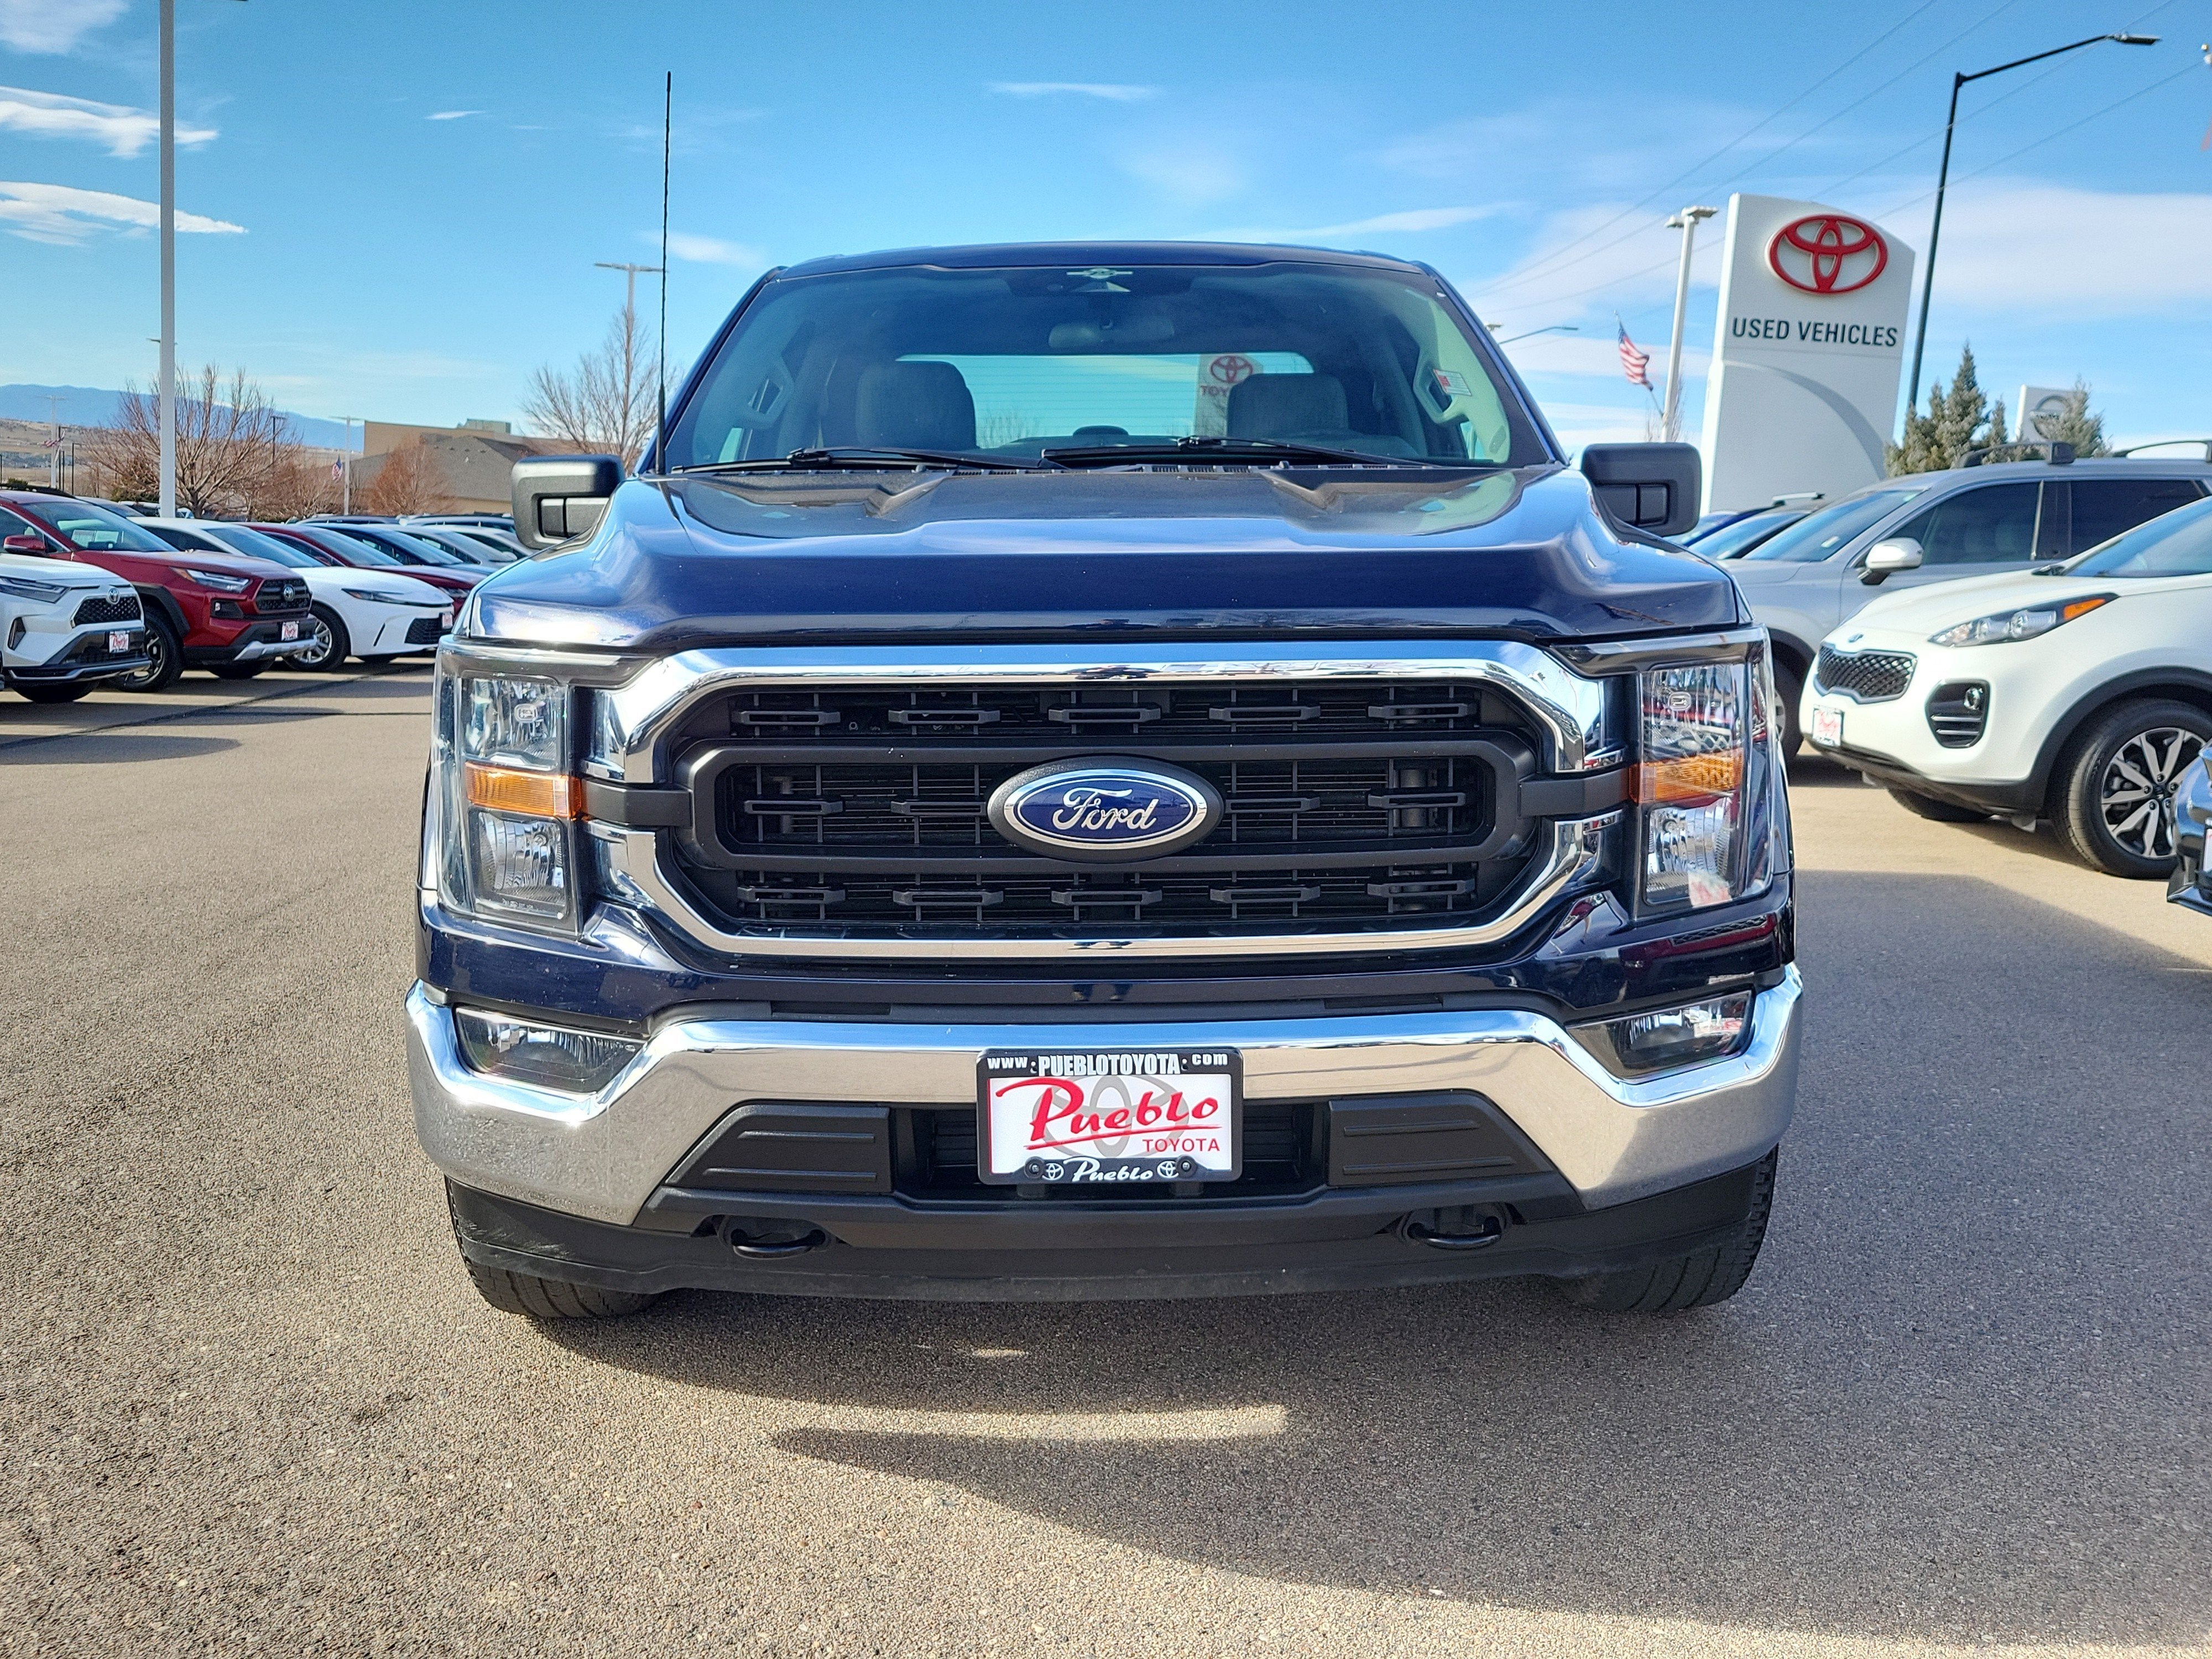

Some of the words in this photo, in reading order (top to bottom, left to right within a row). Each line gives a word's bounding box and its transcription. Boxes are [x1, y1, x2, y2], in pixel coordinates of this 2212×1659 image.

[1733, 317, 1790, 340] USED
[1798, 320, 1897, 347] VEHICLES
[1052, 787, 1160, 830] Ford
[995, 1077, 1218, 1141] Pueblo
[1142, 1138, 1220, 1152] TOYOTA
[1063, 1156, 1153, 1182] Pueblo
